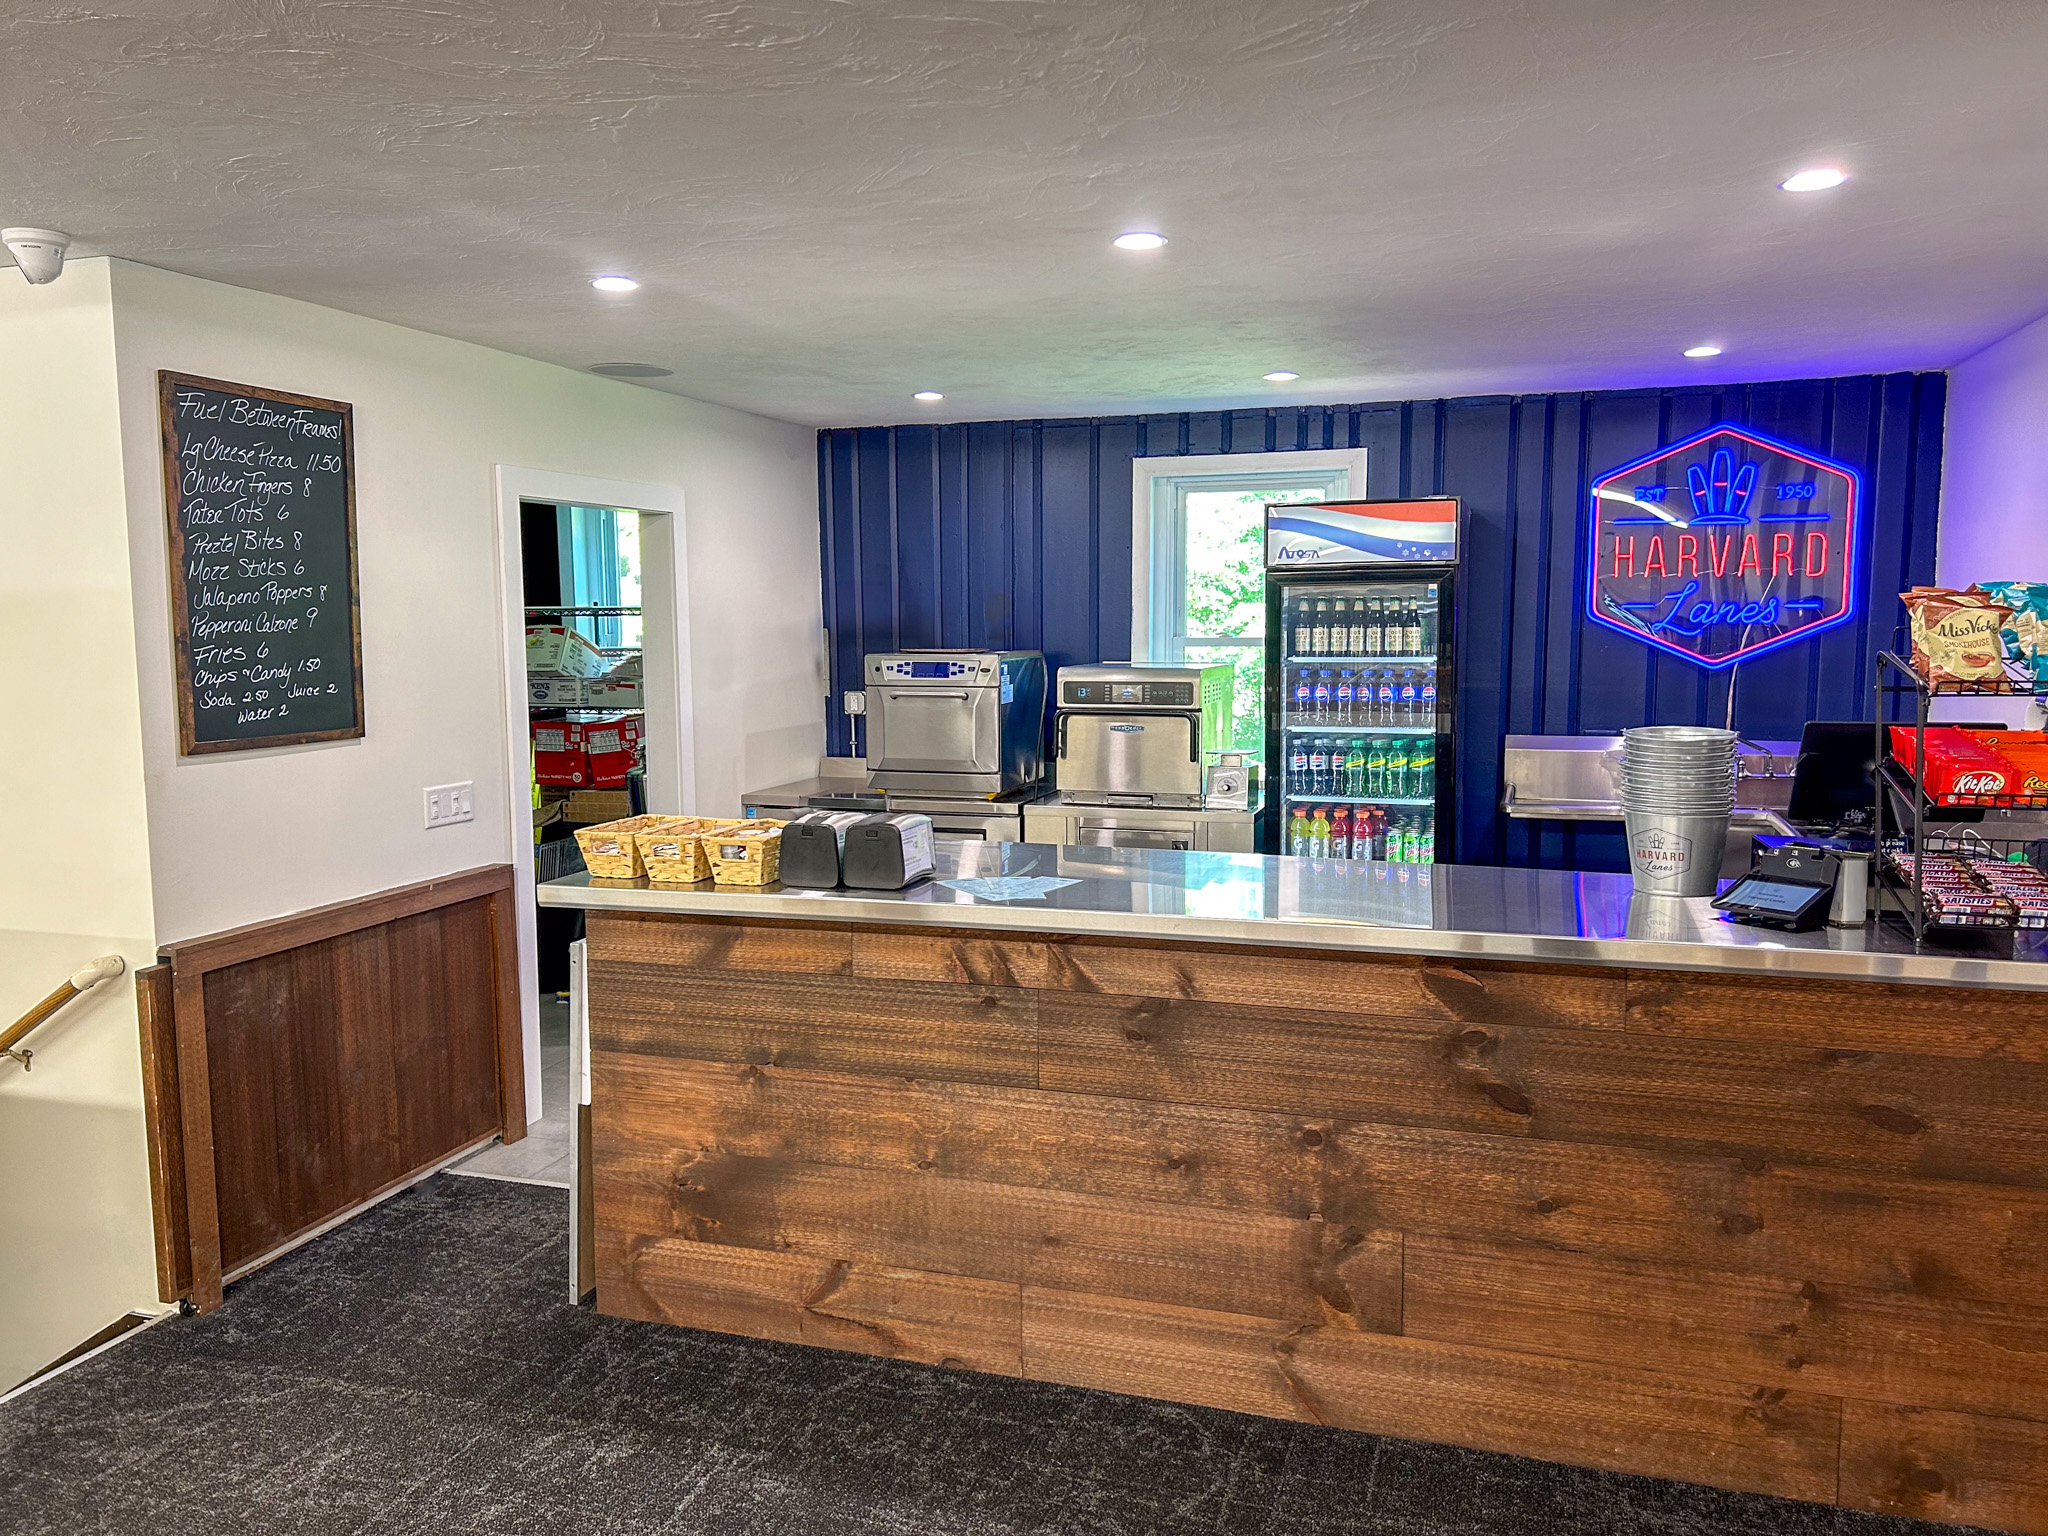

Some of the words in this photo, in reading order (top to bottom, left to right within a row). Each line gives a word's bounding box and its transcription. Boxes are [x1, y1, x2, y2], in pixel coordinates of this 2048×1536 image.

[177, 392, 227, 423] Fuel
[229, 399, 296, 441] Between
[181, 433, 203, 471] Lg
[203, 436, 254, 466] Cheese
[253, 442, 298, 470] Pizza
[306, 453, 341, 474] 11.50
[183, 468, 247, 497] Chicken
[243, 471, 293, 506] Fingers
[303, 478, 312, 497] 8
[1634, 486, 1664, 502] EST
[1776, 483, 1815, 500] 1950
[183, 498, 224, 528] Tater
[224, 497, 264, 524] Tots
[277, 504, 290, 521] 6
[241, 527, 285, 551] Bites
[293, 530, 303, 551] 8
[1613, 532, 1828, 579] HARVARD
[189, 557, 230, 584] Mozz
[238, 558, 287, 578] Sticks
[294, 559, 305, 576] 6
[193, 584, 261, 612] Jalapeno
[260, 581, 313, 605] Poppers
[319, 584, 328, 601] 8
[1652, 580, 1779, 637] Lanes
[191, 610, 253, 640] Pepperoni
[306, 607, 319, 628] 9
[1938, 622, 1970, 638] Miss
[194, 641, 246, 666] Fries
[256, 641, 269, 659] 6
[1943, 637, 1991, 649] SMOKEHOUSE
[194, 668, 238, 688] Chips
[249, 661, 292, 689] Candy
[297, 657, 321, 673] 1.50
[199, 690, 236, 710] Soda
[242, 689, 269, 703] 2.50
[287, 681, 320, 700] Juice
[326, 682, 339, 694] 2
[237, 707, 275, 724] Water
[279, 705, 289, 717] 2
[1636, 848, 1685, 862] HARVARD
[1645, 860, 1673, 873] Lanes
[1944, 896, 1992, 905] SATISFIES
